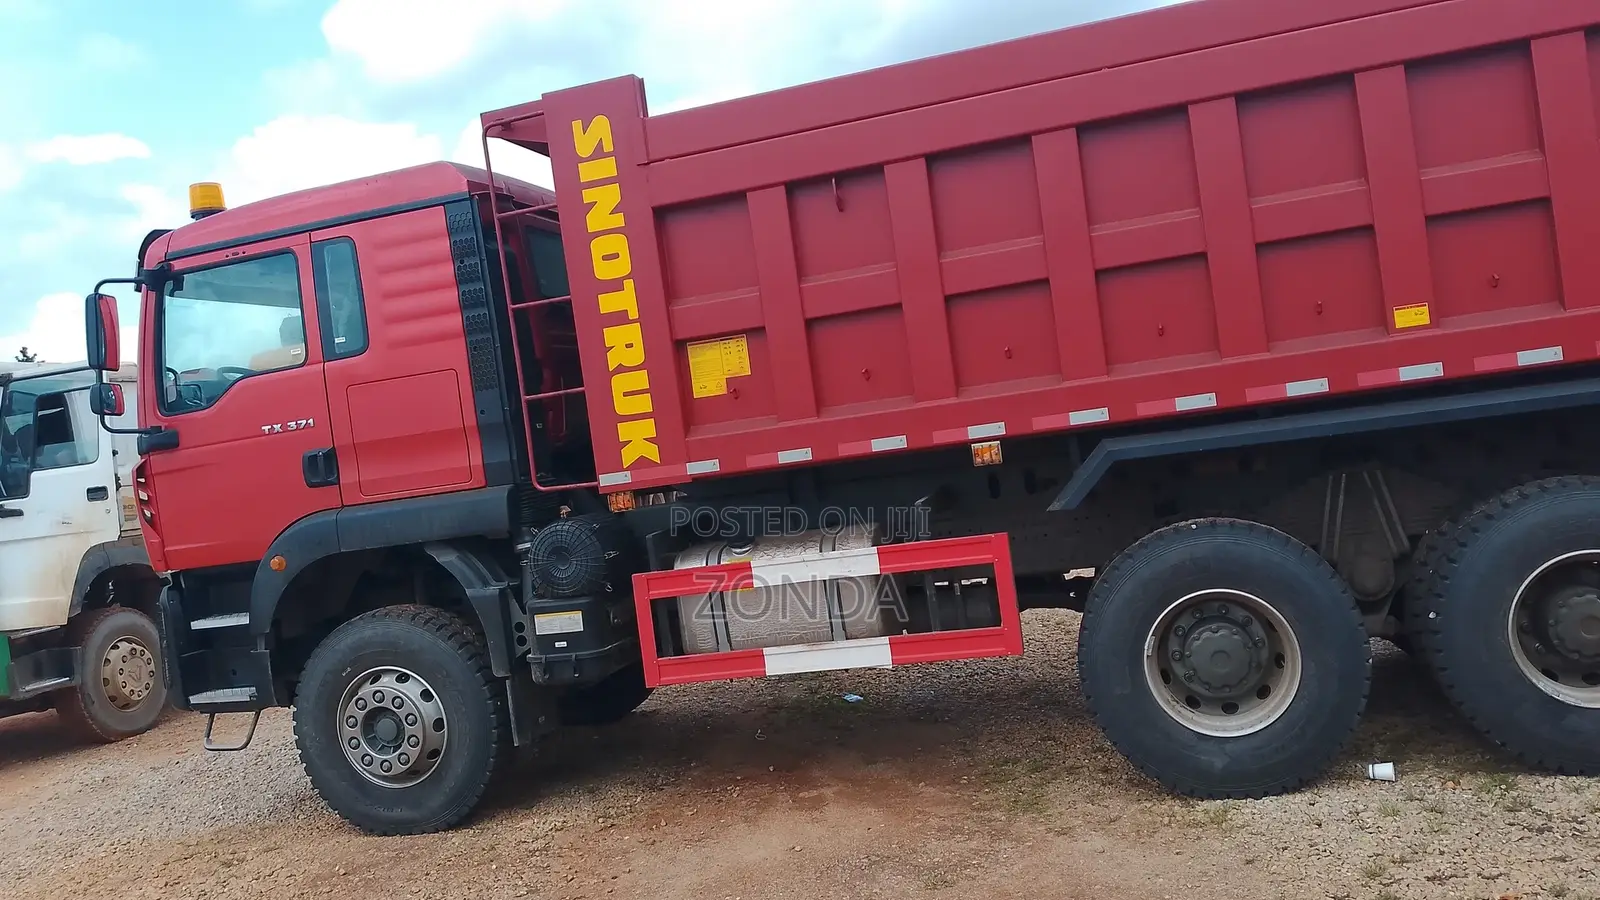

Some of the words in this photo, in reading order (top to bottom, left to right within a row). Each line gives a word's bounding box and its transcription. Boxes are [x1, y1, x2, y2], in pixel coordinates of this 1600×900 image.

[571, 114, 661, 469] SINOTRUK
[261, 423, 283, 435] TX
[287, 418, 314, 431] 371
